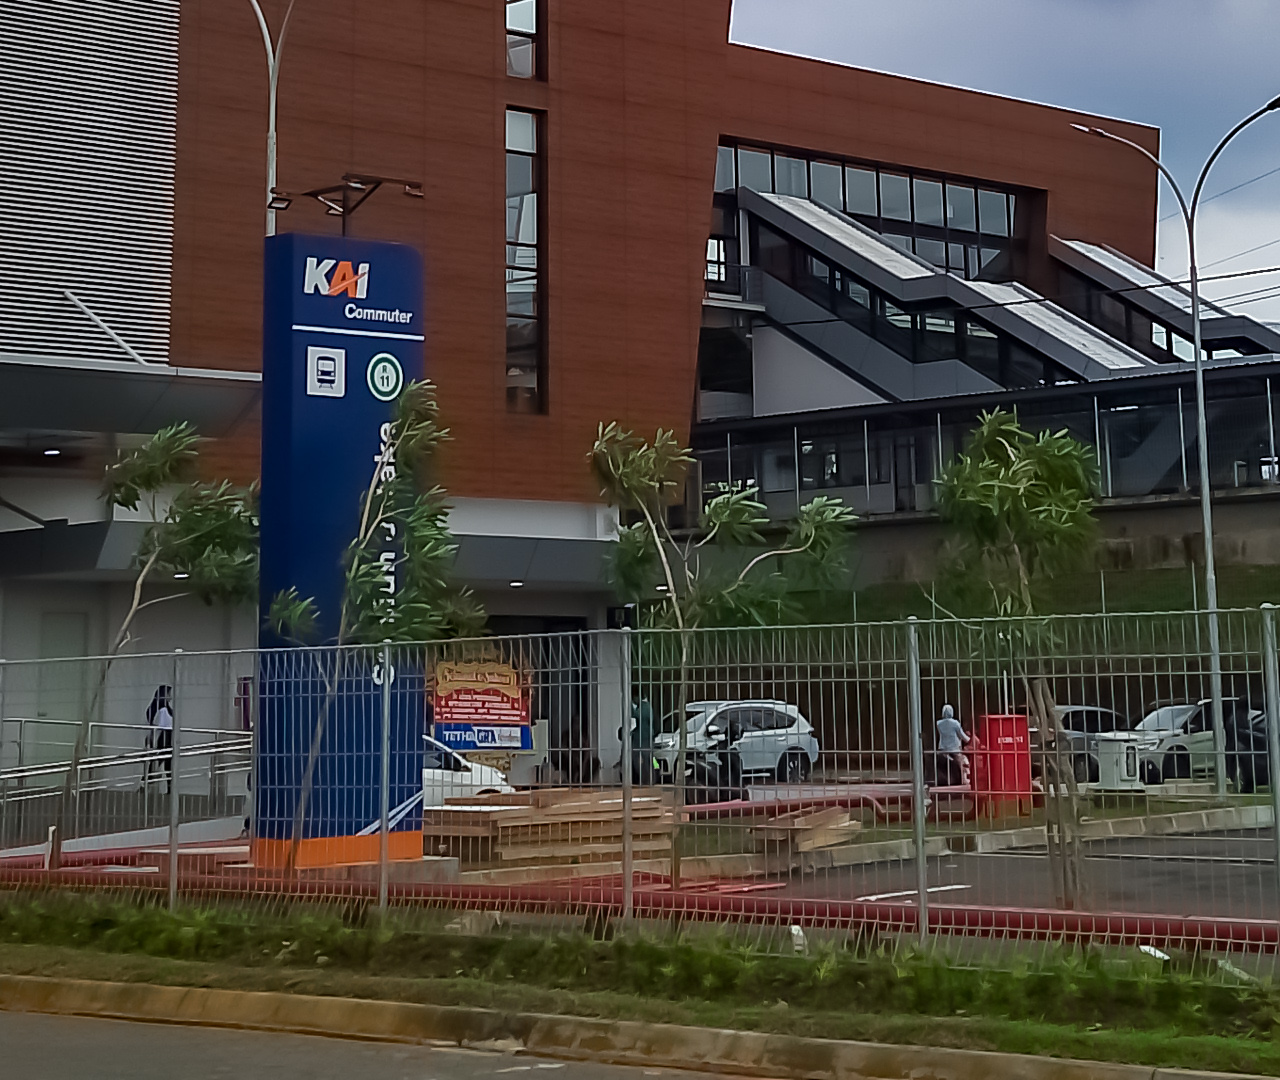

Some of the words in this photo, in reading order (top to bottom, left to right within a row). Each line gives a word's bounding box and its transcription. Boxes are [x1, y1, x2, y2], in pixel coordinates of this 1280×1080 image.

[303, 257, 370, 299] KAI
[345, 303, 413, 323] Commuter
[379, 375, 390, 387] 11
[374, 422, 397, 541] Jake
[372, 551, 396, 686] Siun
